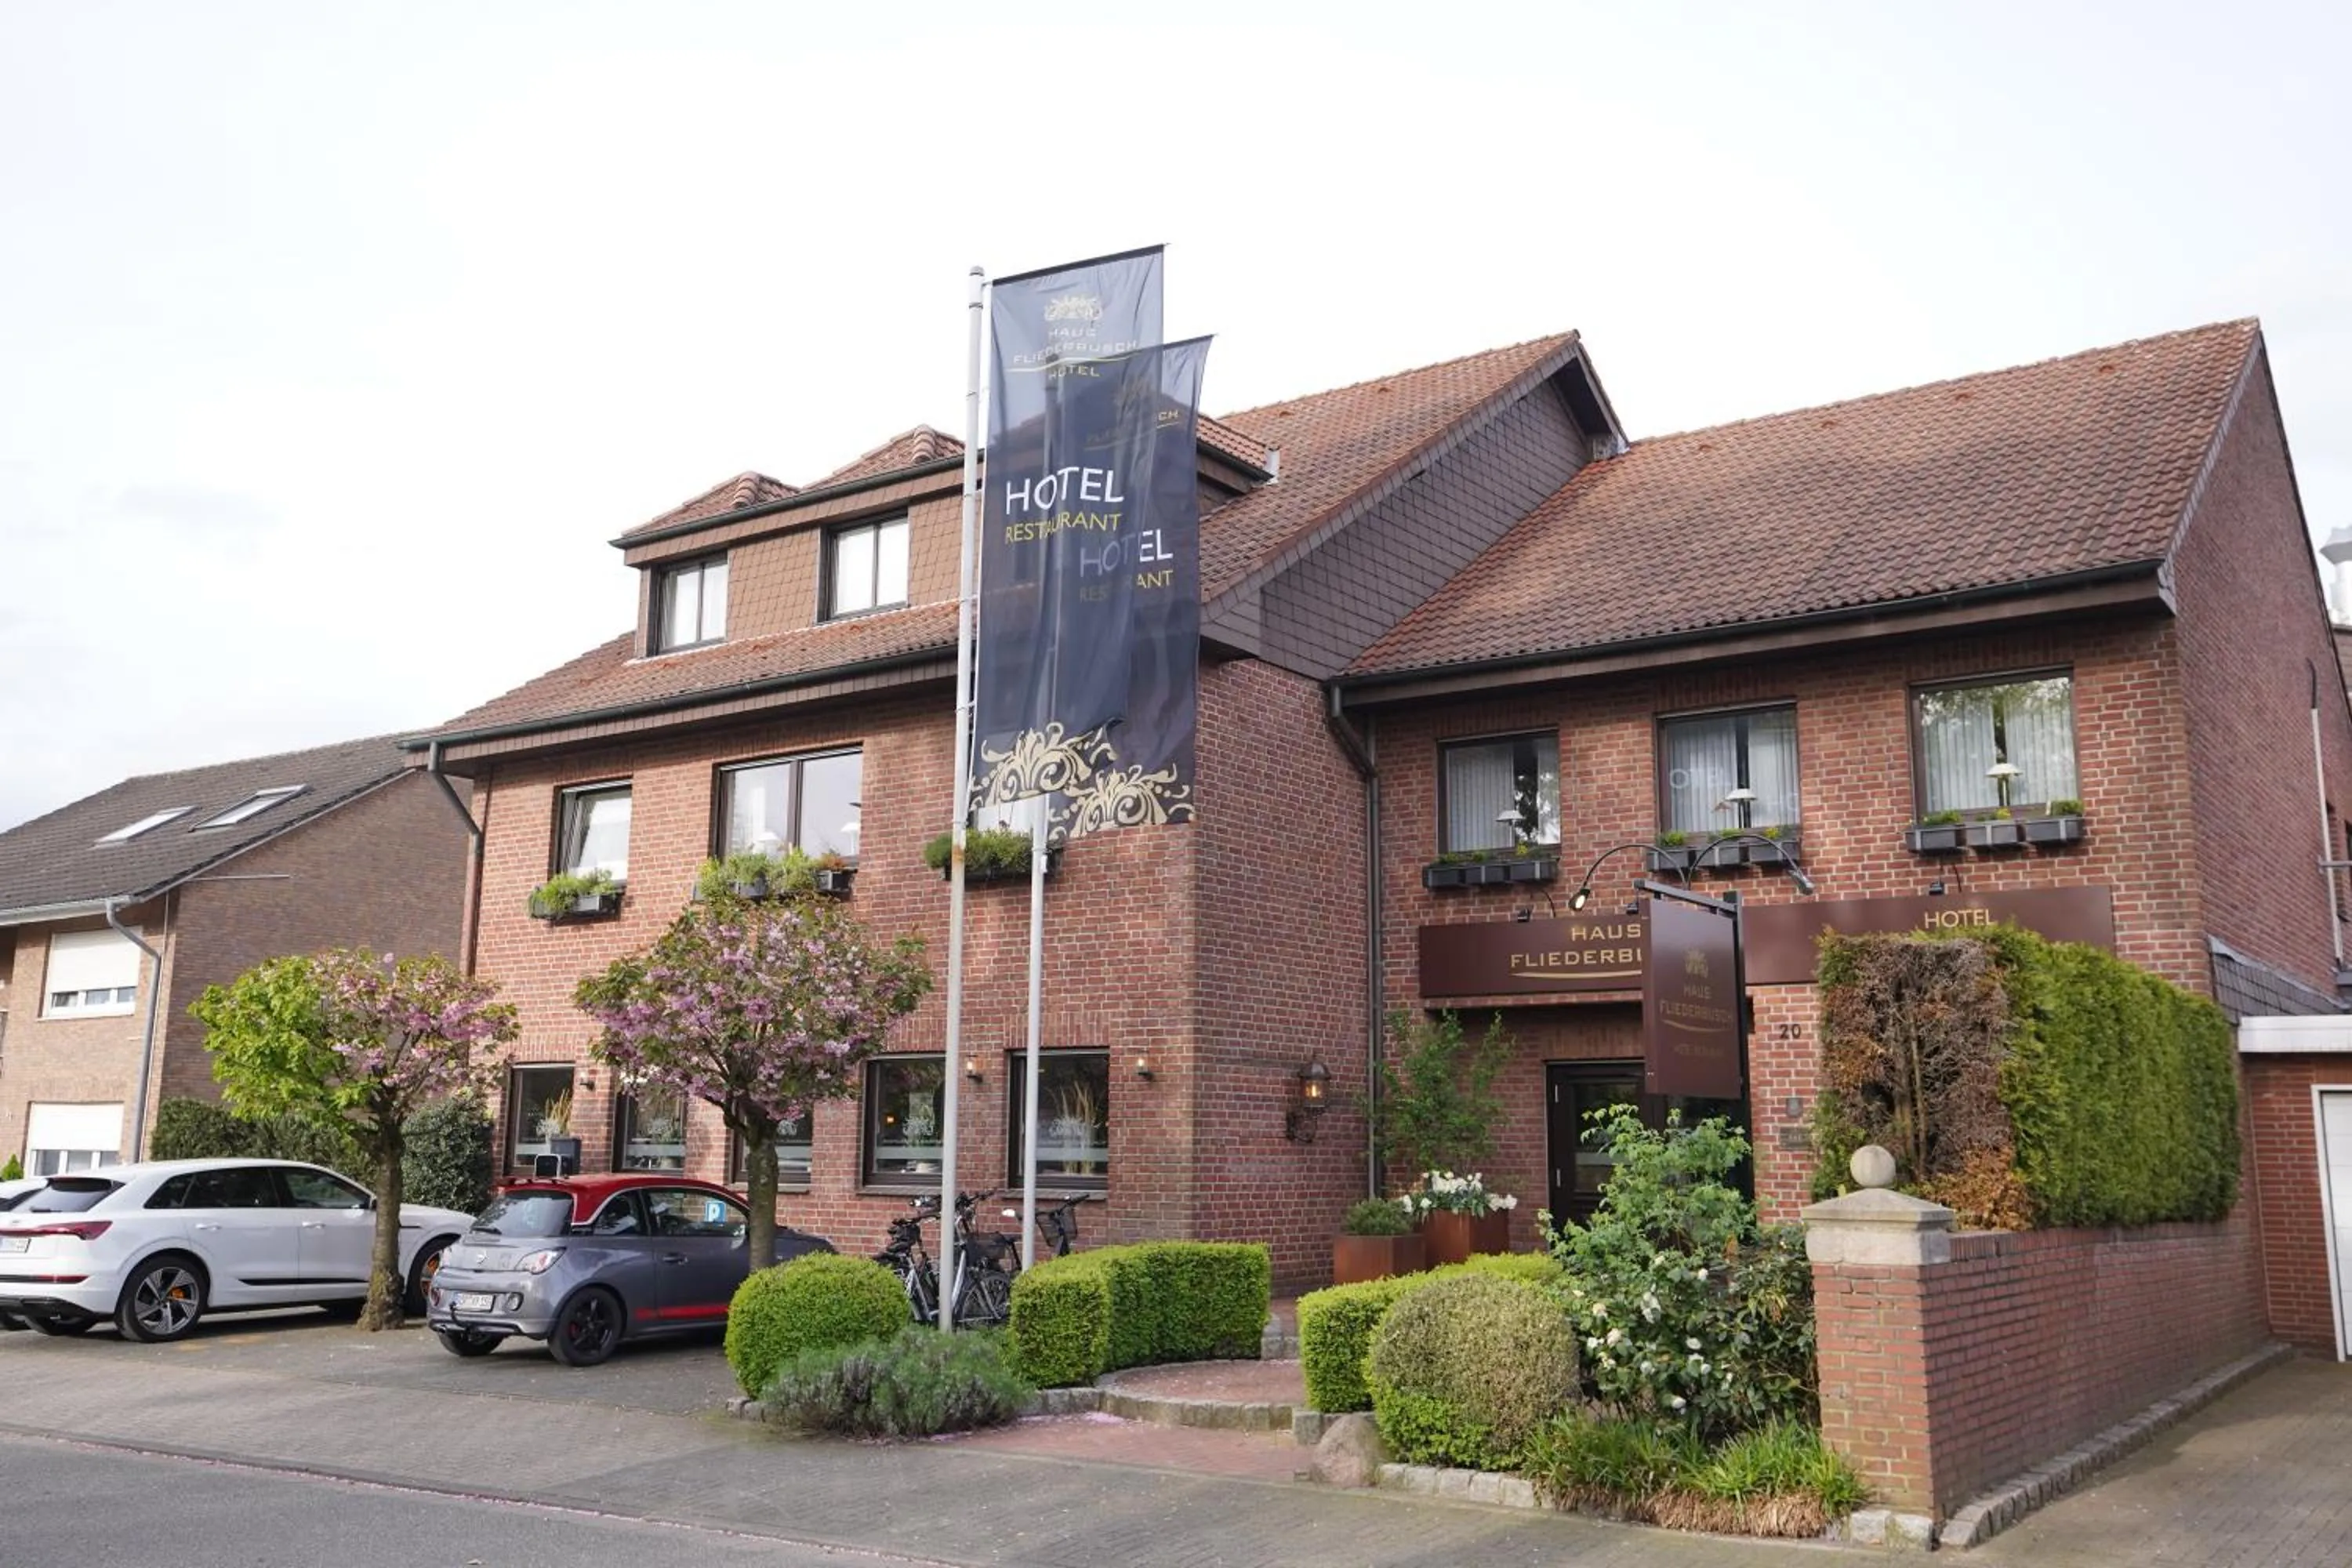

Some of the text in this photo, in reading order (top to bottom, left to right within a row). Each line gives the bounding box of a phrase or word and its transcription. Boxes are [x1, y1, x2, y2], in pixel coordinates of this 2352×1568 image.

[1047, 327, 1097, 339] HAUS
[1048, 365, 1101, 380] HOTEL
[1006, 466, 1125, 516] HOTEL
[1004, 511, 1122, 546] RESTAURANT
[1080, 528, 1174, 578] HOTEL
[1924, 908, 1998, 929] HOTEL
[1571, 924, 1642, 942] HAUS
[1682, 983, 1713, 1000] HAUS
[1779, 1023, 1802, 1040] 20
